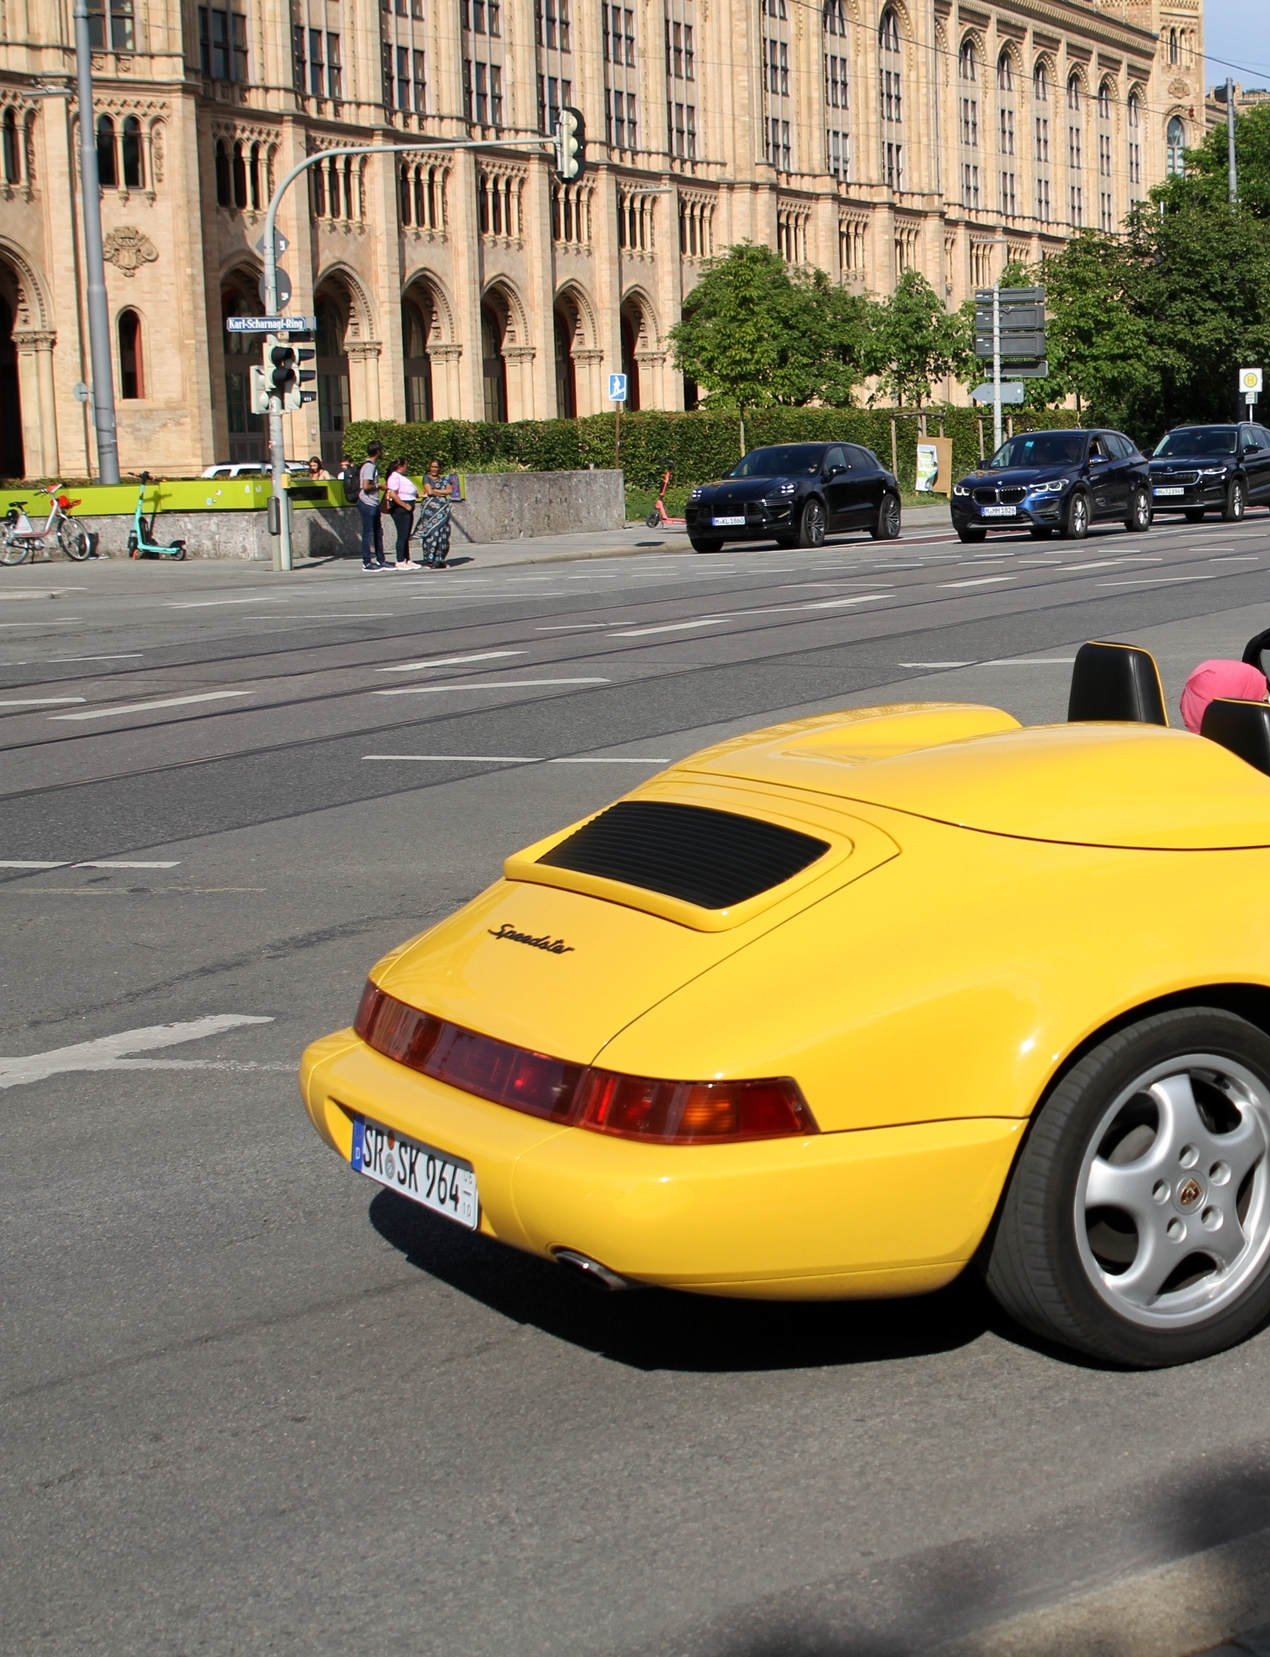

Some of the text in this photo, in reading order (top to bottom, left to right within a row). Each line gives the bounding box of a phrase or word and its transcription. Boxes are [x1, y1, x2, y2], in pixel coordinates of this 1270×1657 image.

[229, 319, 303, 329] Karl-Scharnagl-Ring
[487, 923, 575, 954] Speedster
[363, 1124, 460, 1212] SR SK 964
